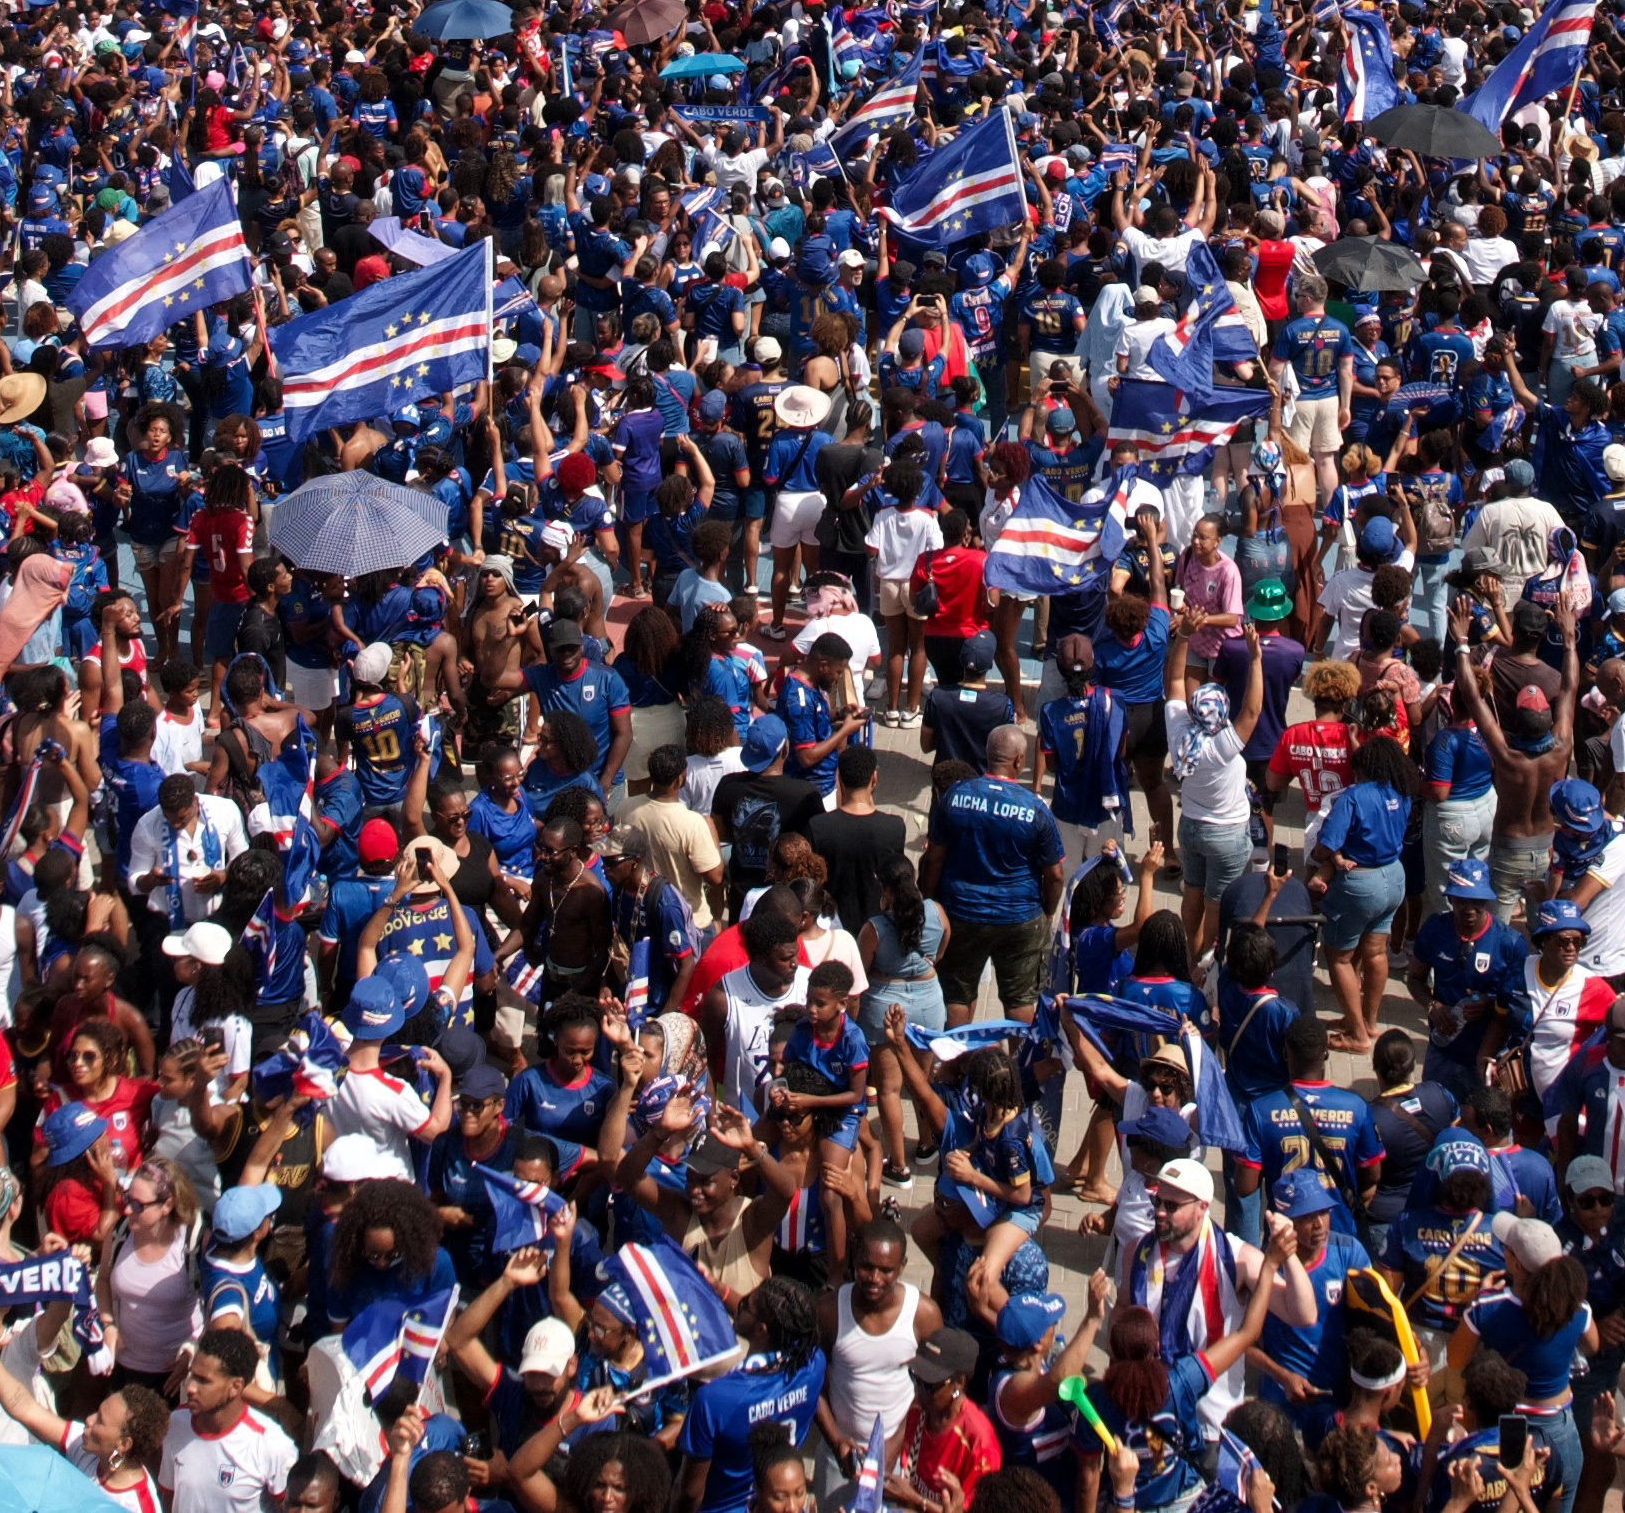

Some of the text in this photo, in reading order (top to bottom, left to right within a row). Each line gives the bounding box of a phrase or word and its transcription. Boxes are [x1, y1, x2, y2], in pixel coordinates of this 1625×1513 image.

[684, 106, 754, 117] CABO VERDE
[1304, 350, 1335, 377] 10
[212, 534, 226, 573] 5
[361, 729, 400, 761] 10
[1290, 745, 1348, 758] CABO VERDE
[952, 795, 1035, 822] AICHA LOPES
[1313, 1111, 1354, 1125] VERDE
[748, 1384, 808, 1424] CABO VERDE
